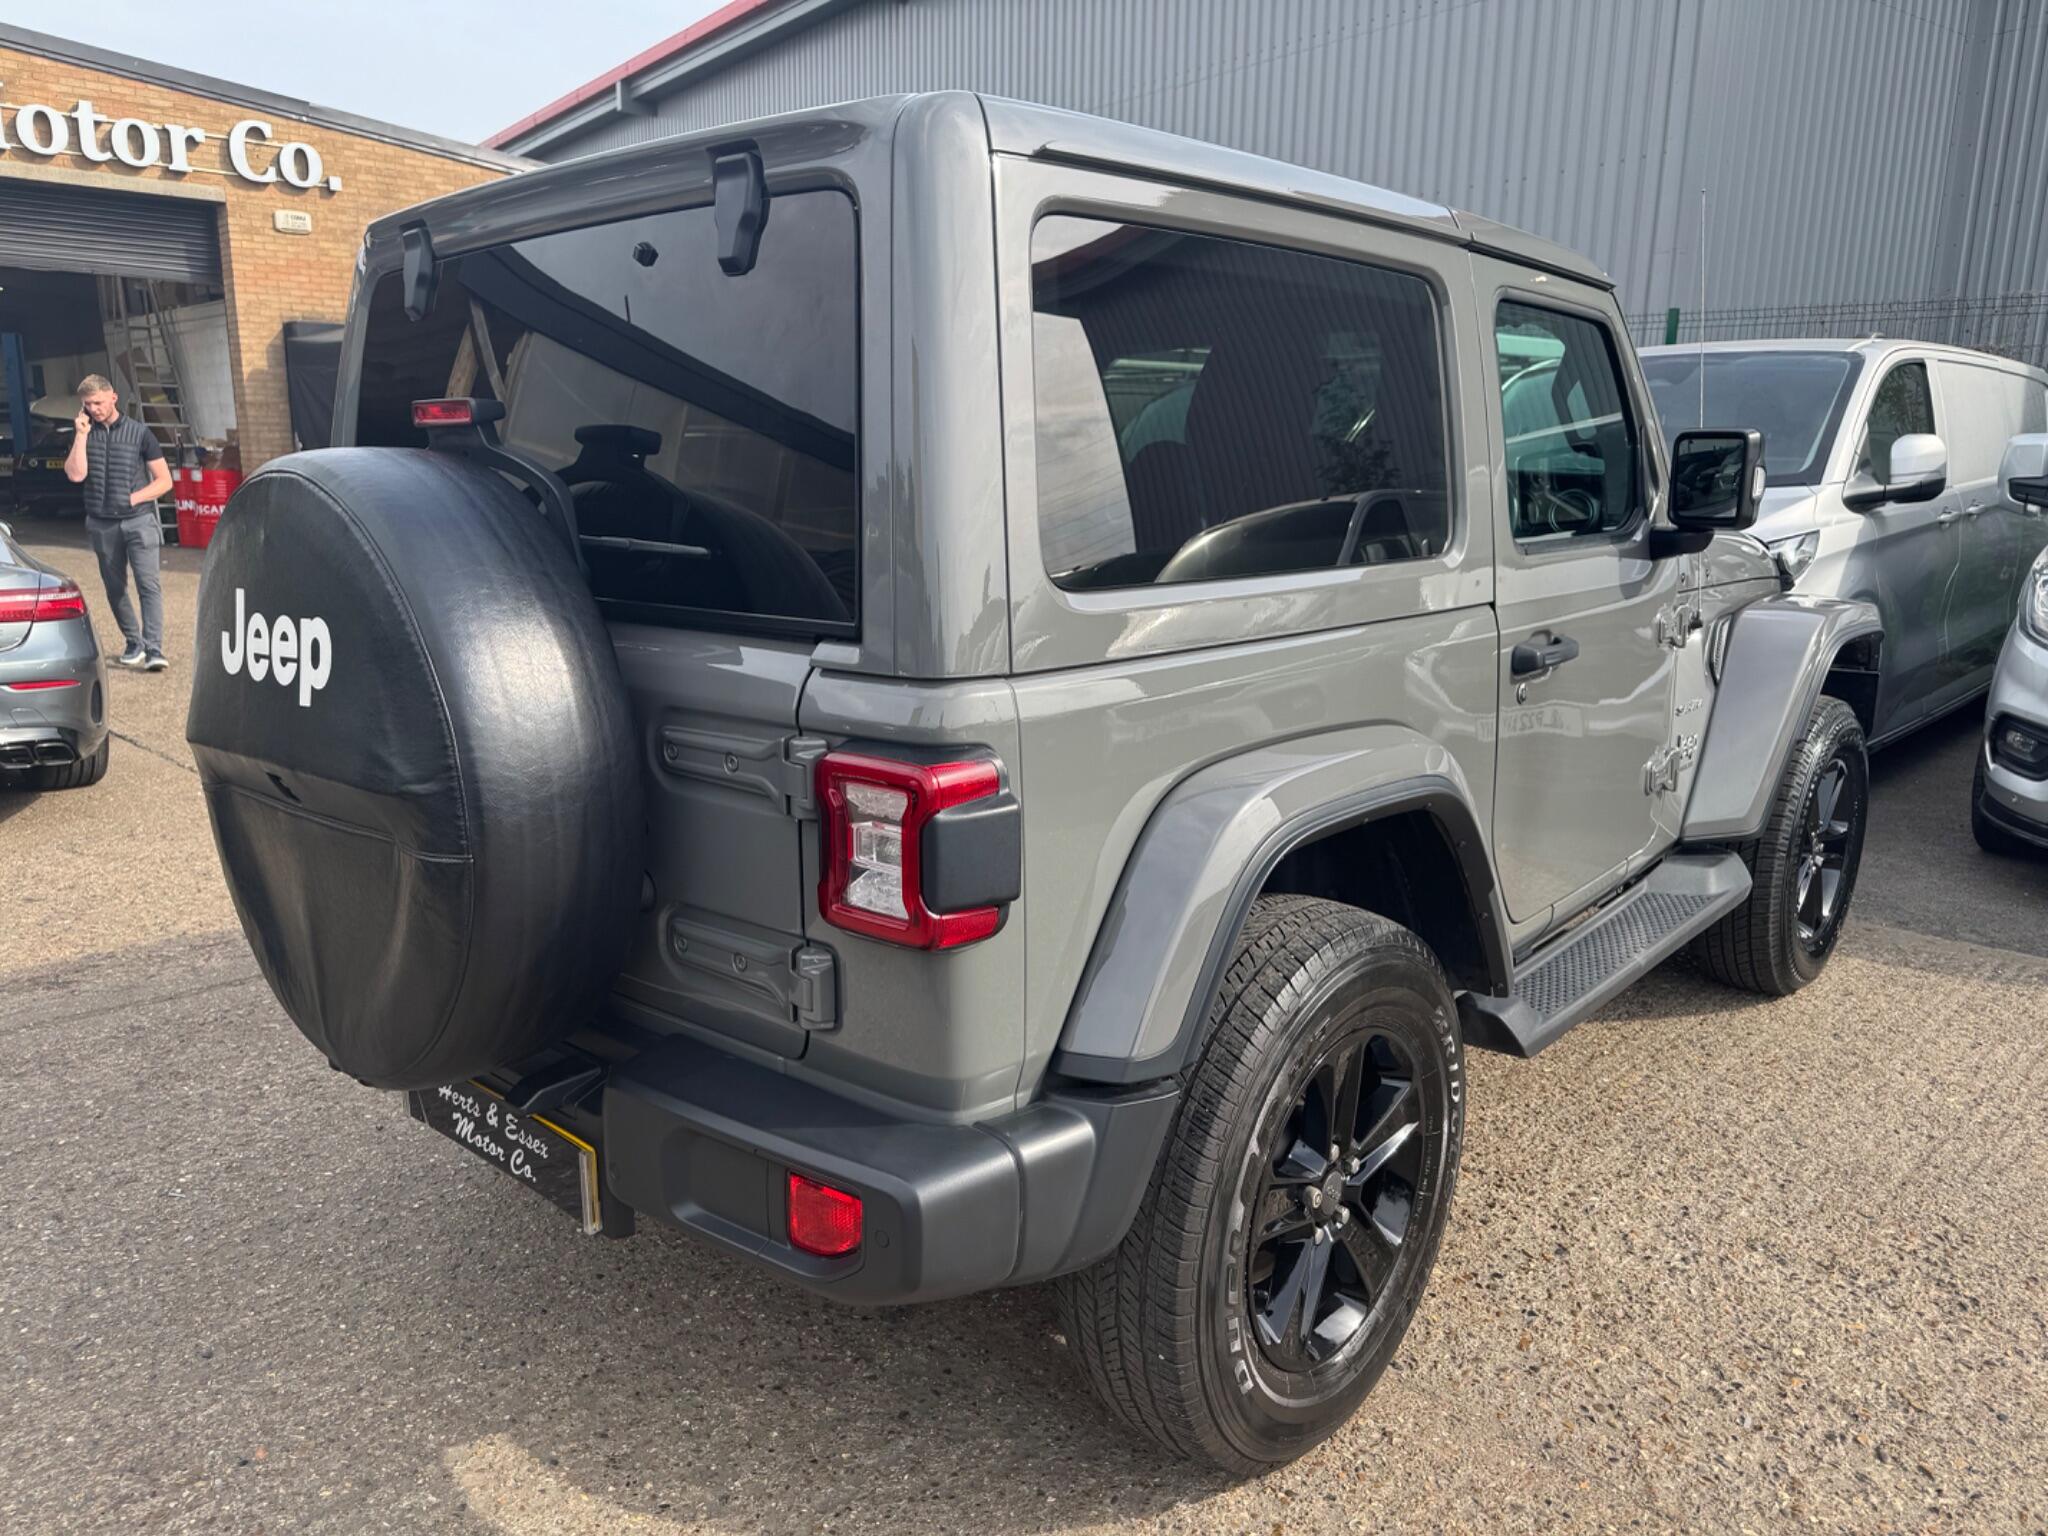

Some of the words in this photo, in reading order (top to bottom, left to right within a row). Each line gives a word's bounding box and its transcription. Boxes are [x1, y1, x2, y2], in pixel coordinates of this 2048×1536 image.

[0, 82, 205, 173] otor
[229, 119, 343, 192] Co.
[221, 587, 332, 708] Jeep
[438, 1084, 481, 1118] Herts
[486, 1102, 499, 1128] &
[504, 1113, 549, 1159] Essex
[452, 1111, 505, 1162] Motor
[510, 1148, 537, 1183] Co.
